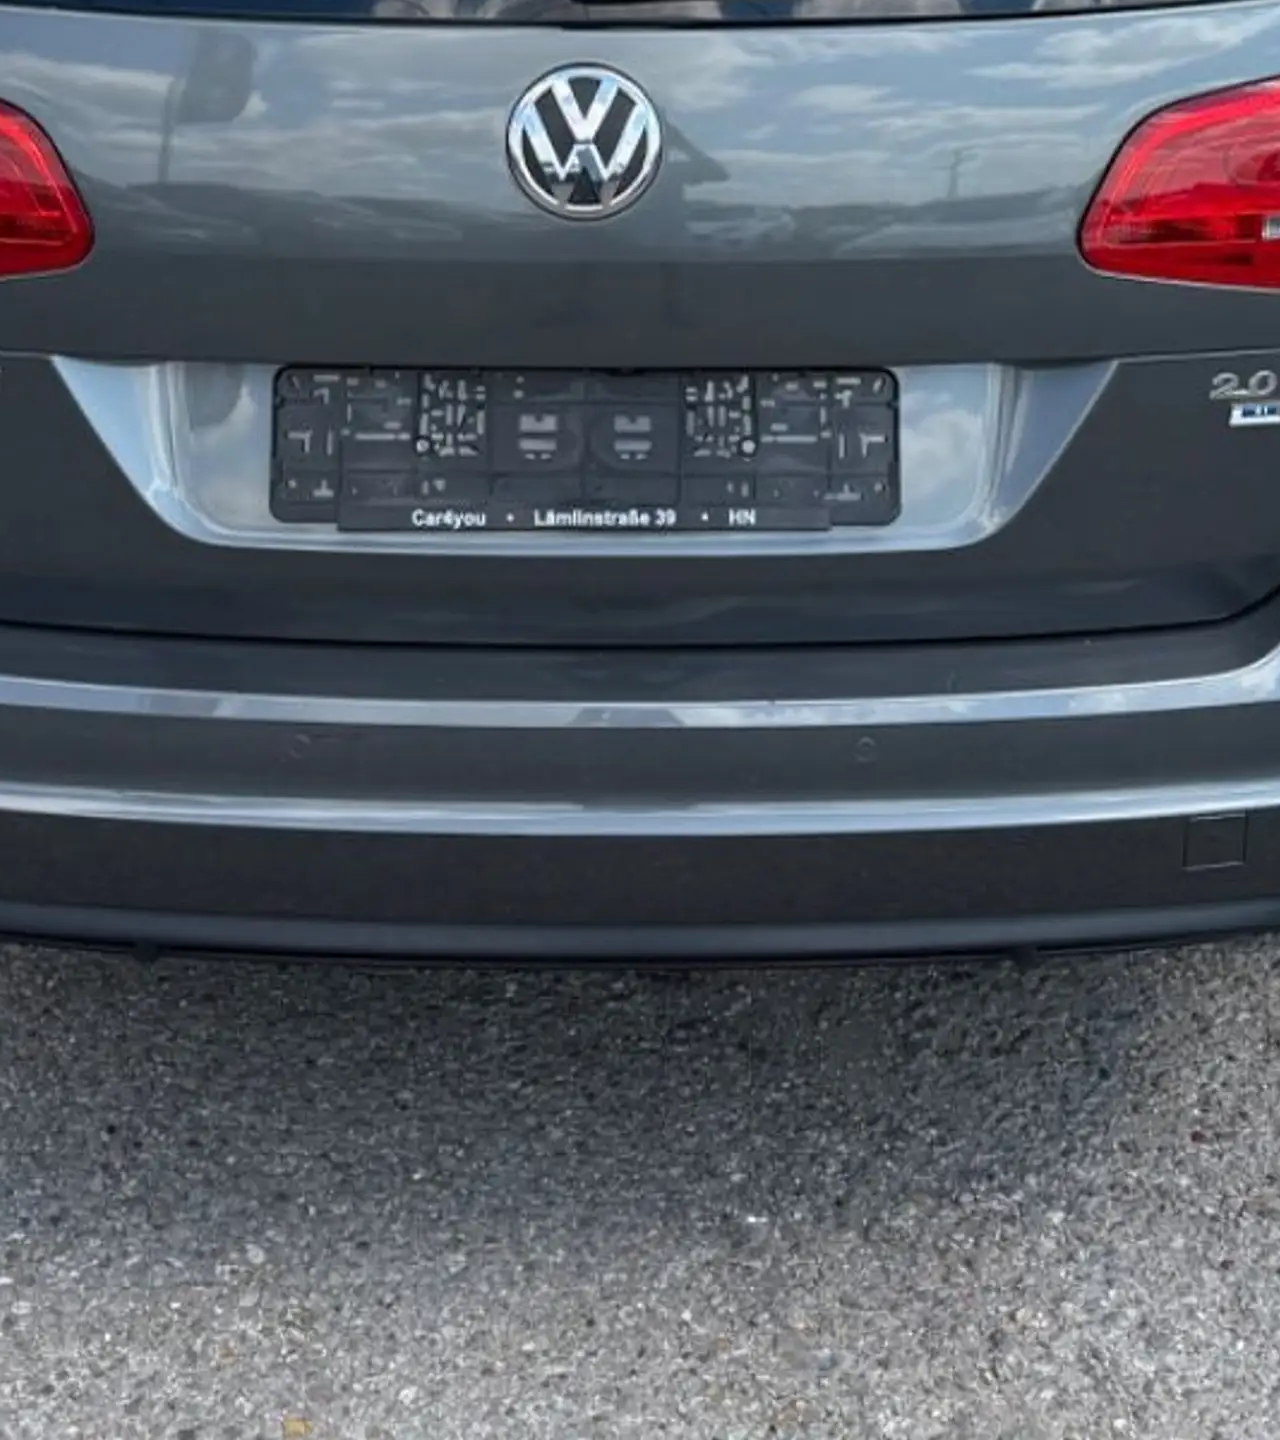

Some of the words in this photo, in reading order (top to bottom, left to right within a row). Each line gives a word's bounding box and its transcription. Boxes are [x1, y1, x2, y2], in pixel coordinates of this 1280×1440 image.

[411, 508, 487, 530] Car4you
[654, 508, 677, 526] 39
[728, 508, 757, 526] HN
